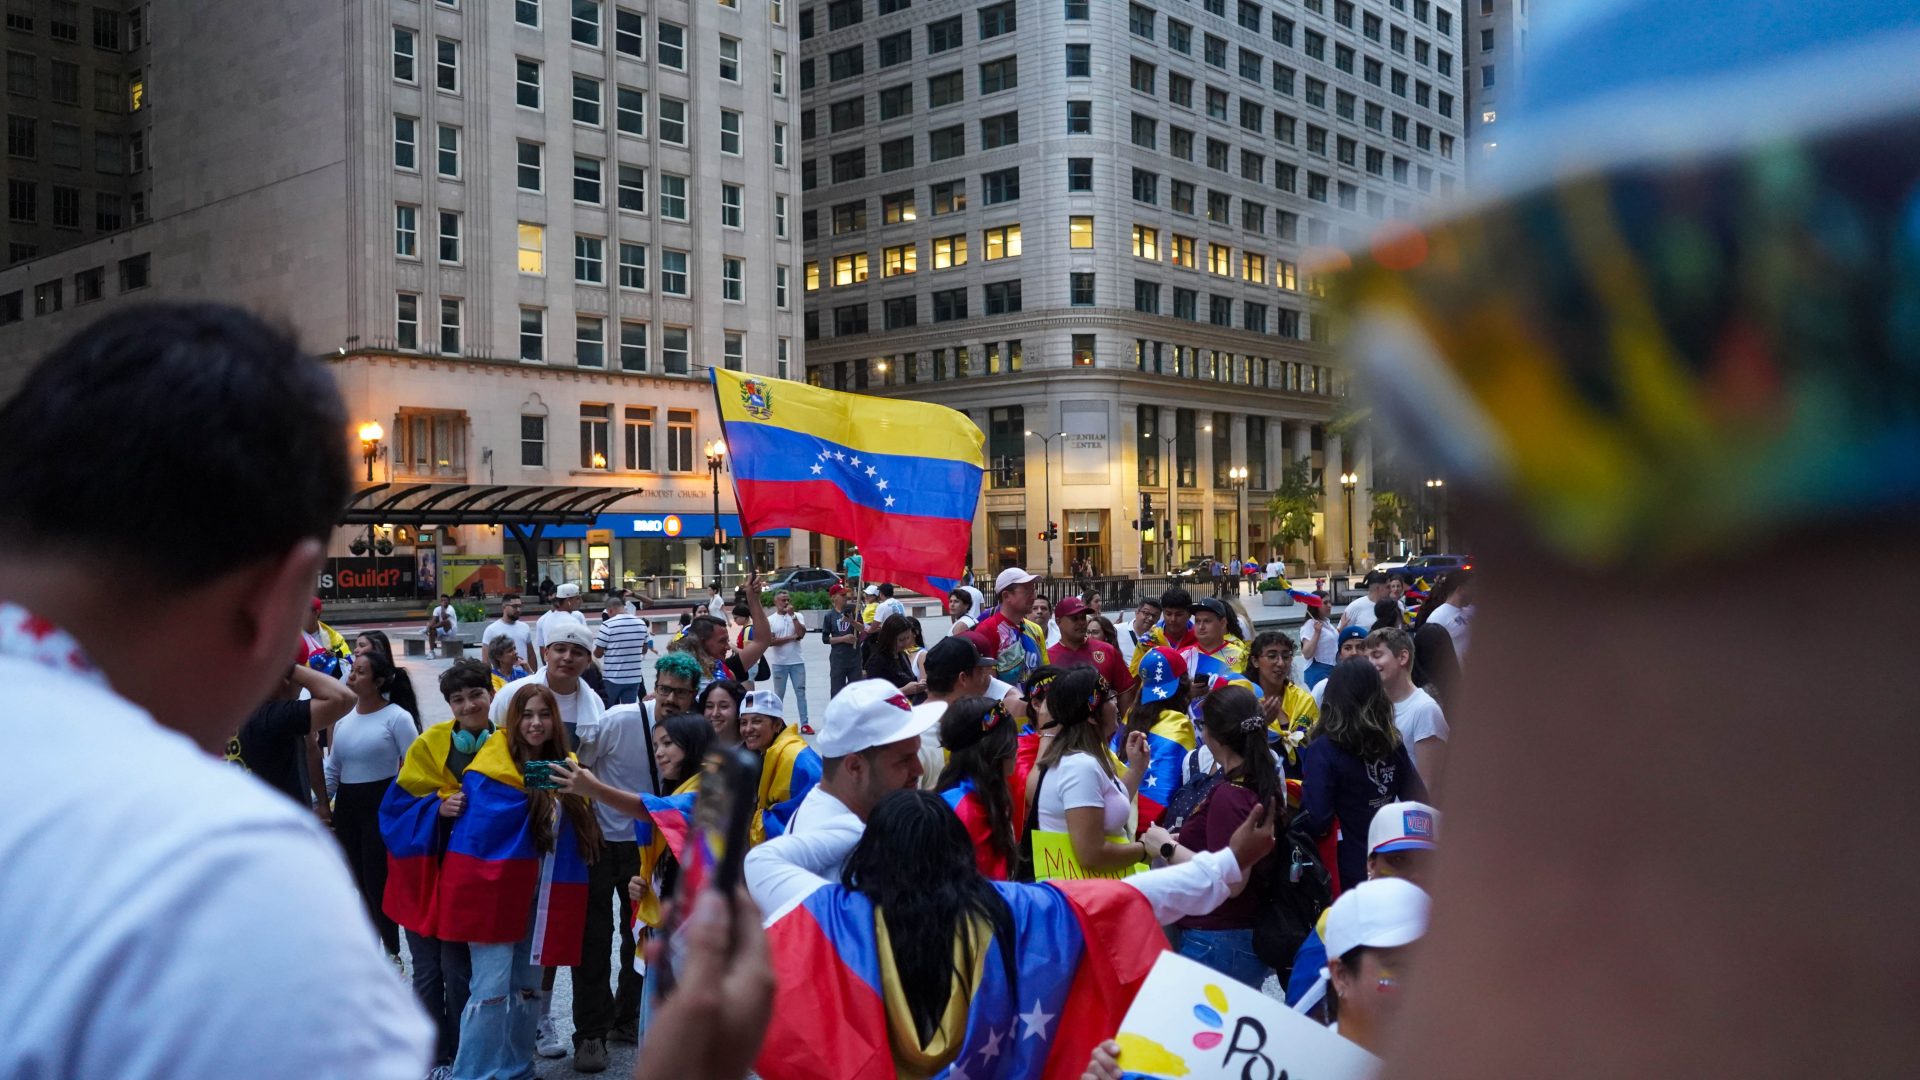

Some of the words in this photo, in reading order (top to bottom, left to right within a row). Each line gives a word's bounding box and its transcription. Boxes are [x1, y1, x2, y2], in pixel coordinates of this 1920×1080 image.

[677, 489, 707, 498] CHURCH
[633, 519, 663, 532] BMO
[317, 570, 334, 588] is
[338, 567, 400, 588] Guild?
[1382, 772, 1394, 784] 29
[1222, 1016, 1289, 1080] Po
